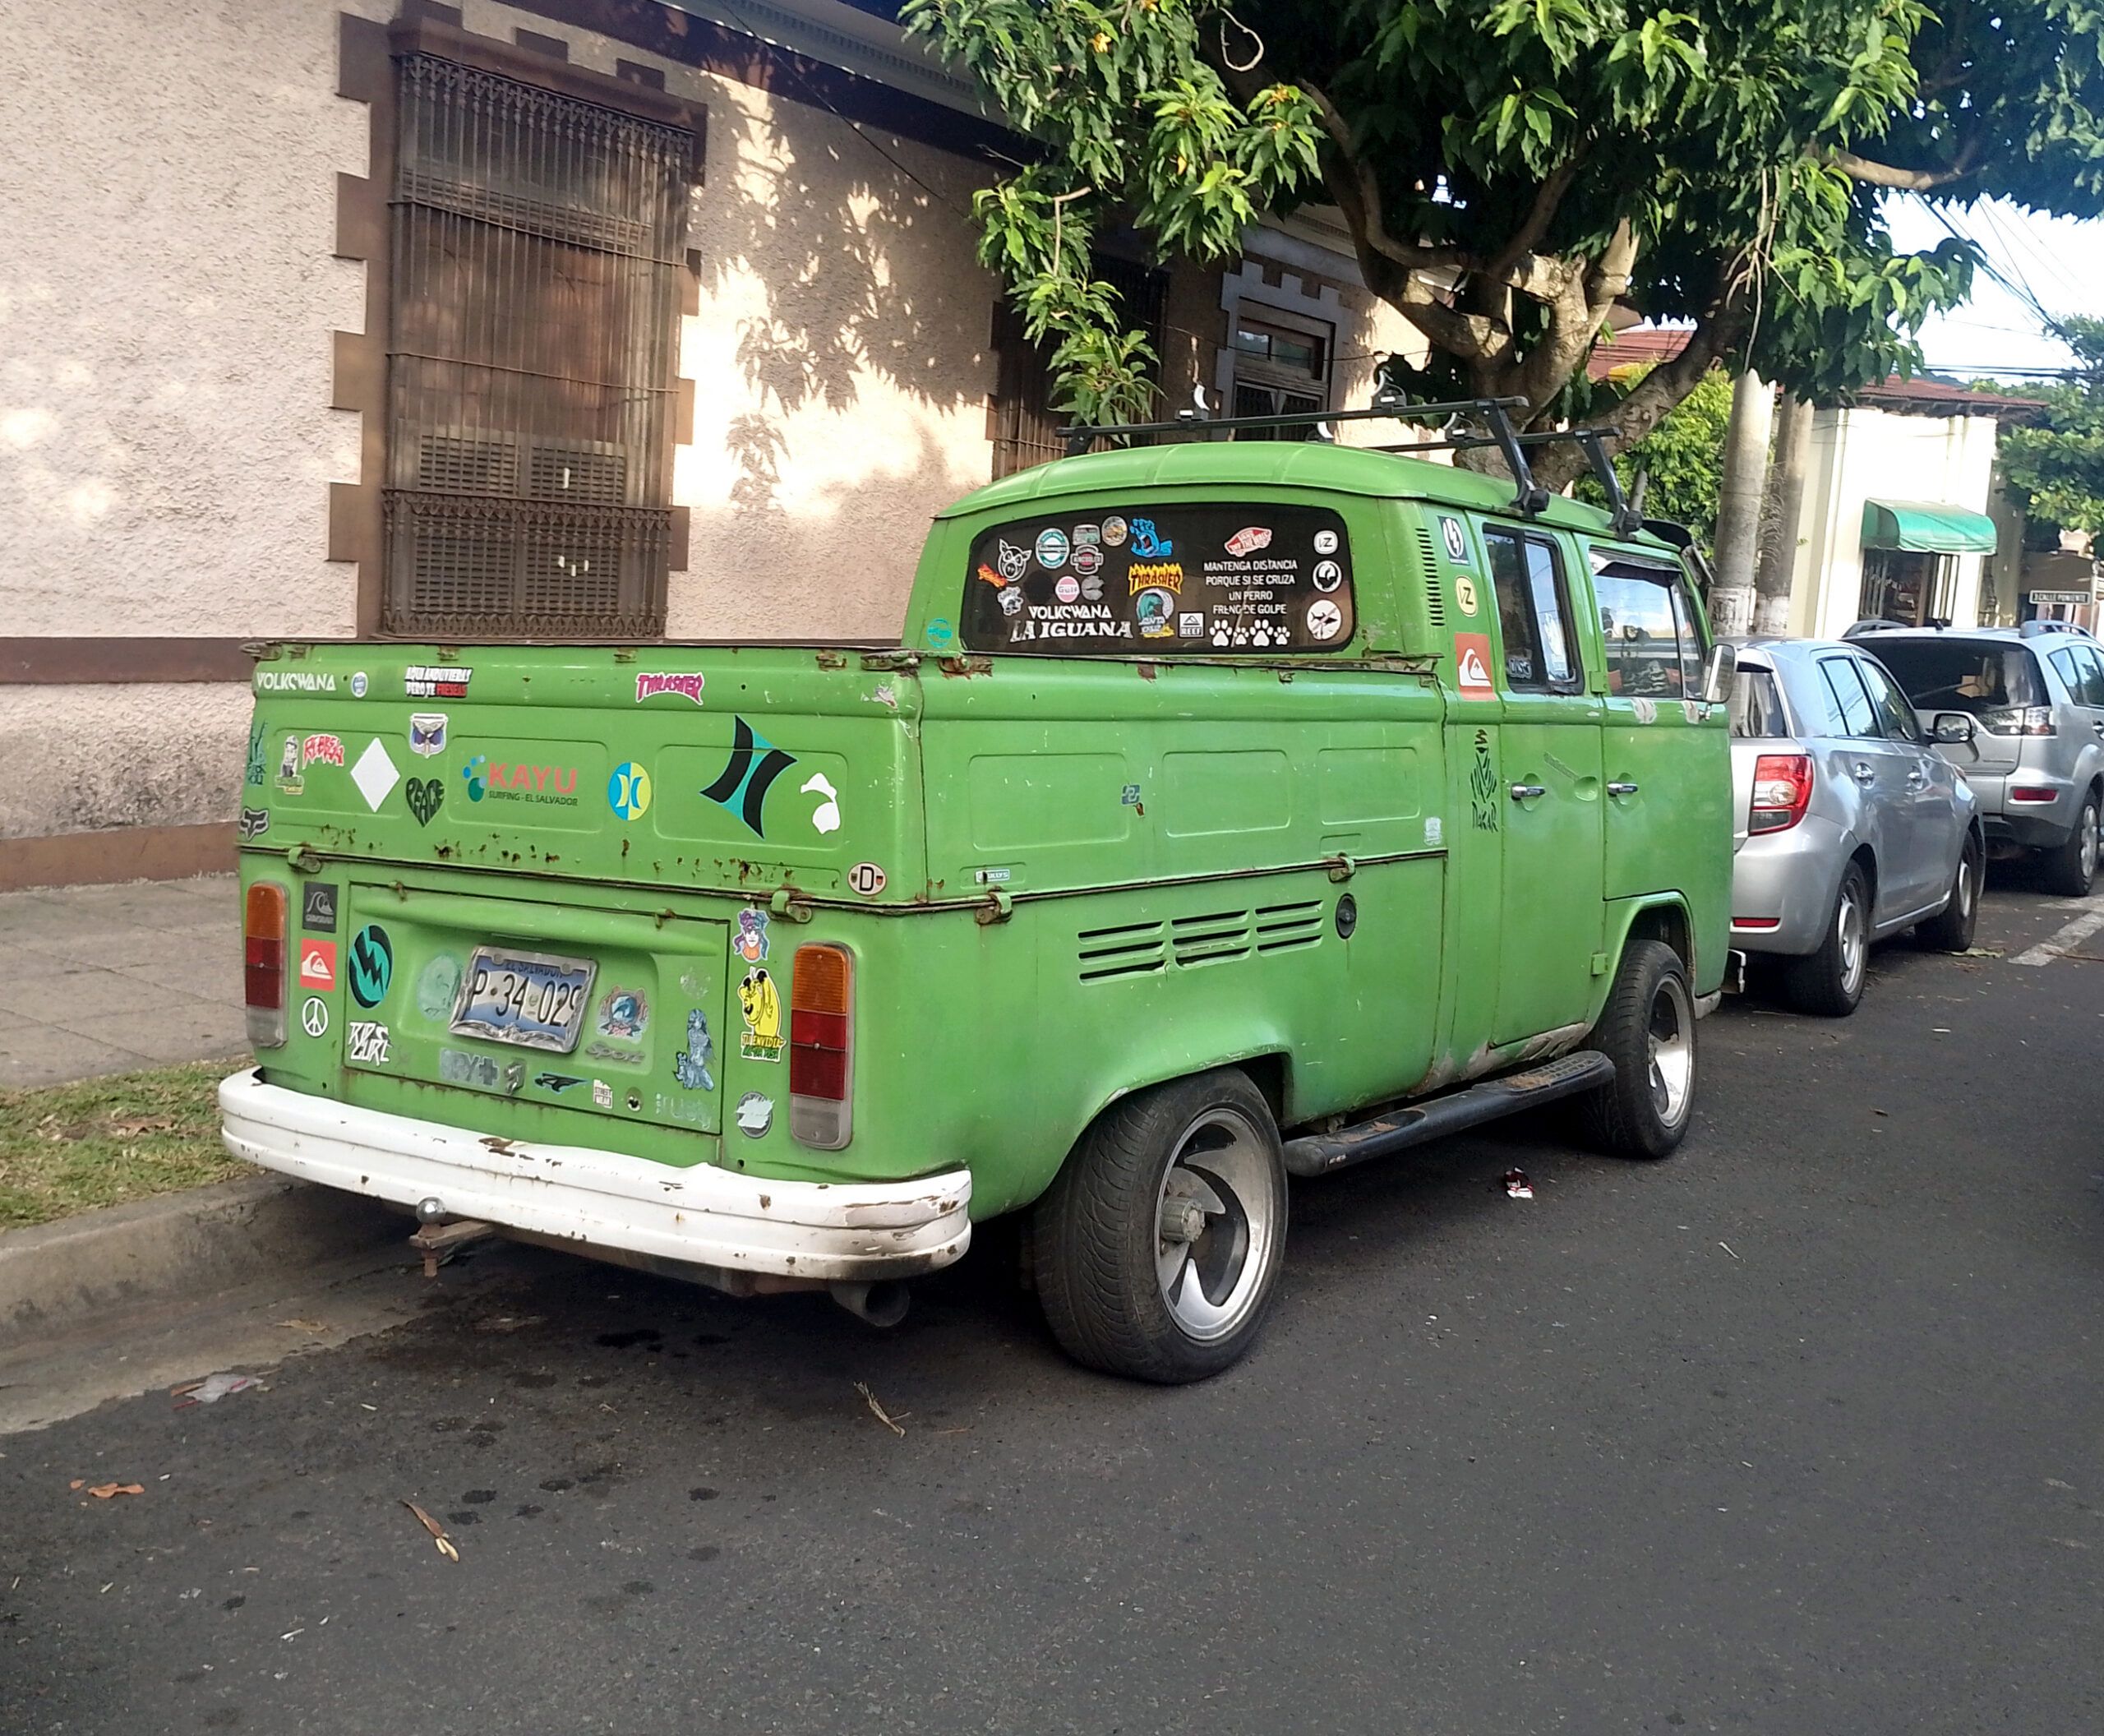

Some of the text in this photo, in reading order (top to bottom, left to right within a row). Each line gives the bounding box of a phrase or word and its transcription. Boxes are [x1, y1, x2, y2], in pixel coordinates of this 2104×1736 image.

[1203, 560, 1298, 571] MANTENGA DISTANCIA
[1131, 574, 1181, 591] THRASHER
[1206, 575, 1295, 587] PORQUE SI SE CRUZA
[1229, 591, 1273, 601] UN PERRO
[1257, 604, 1287, 615] GOLPE
[1010, 620, 1133, 643] LA IGUANA
[489, 762, 578, 794] KAYU
[488, 790, 520, 801] SURFING
[525, 794, 534, 802] EL
[536, 796, 578, 806] SALVADOR
[860, 866, 874, 891] D
[586, 1042, 645, 1064] Sport
